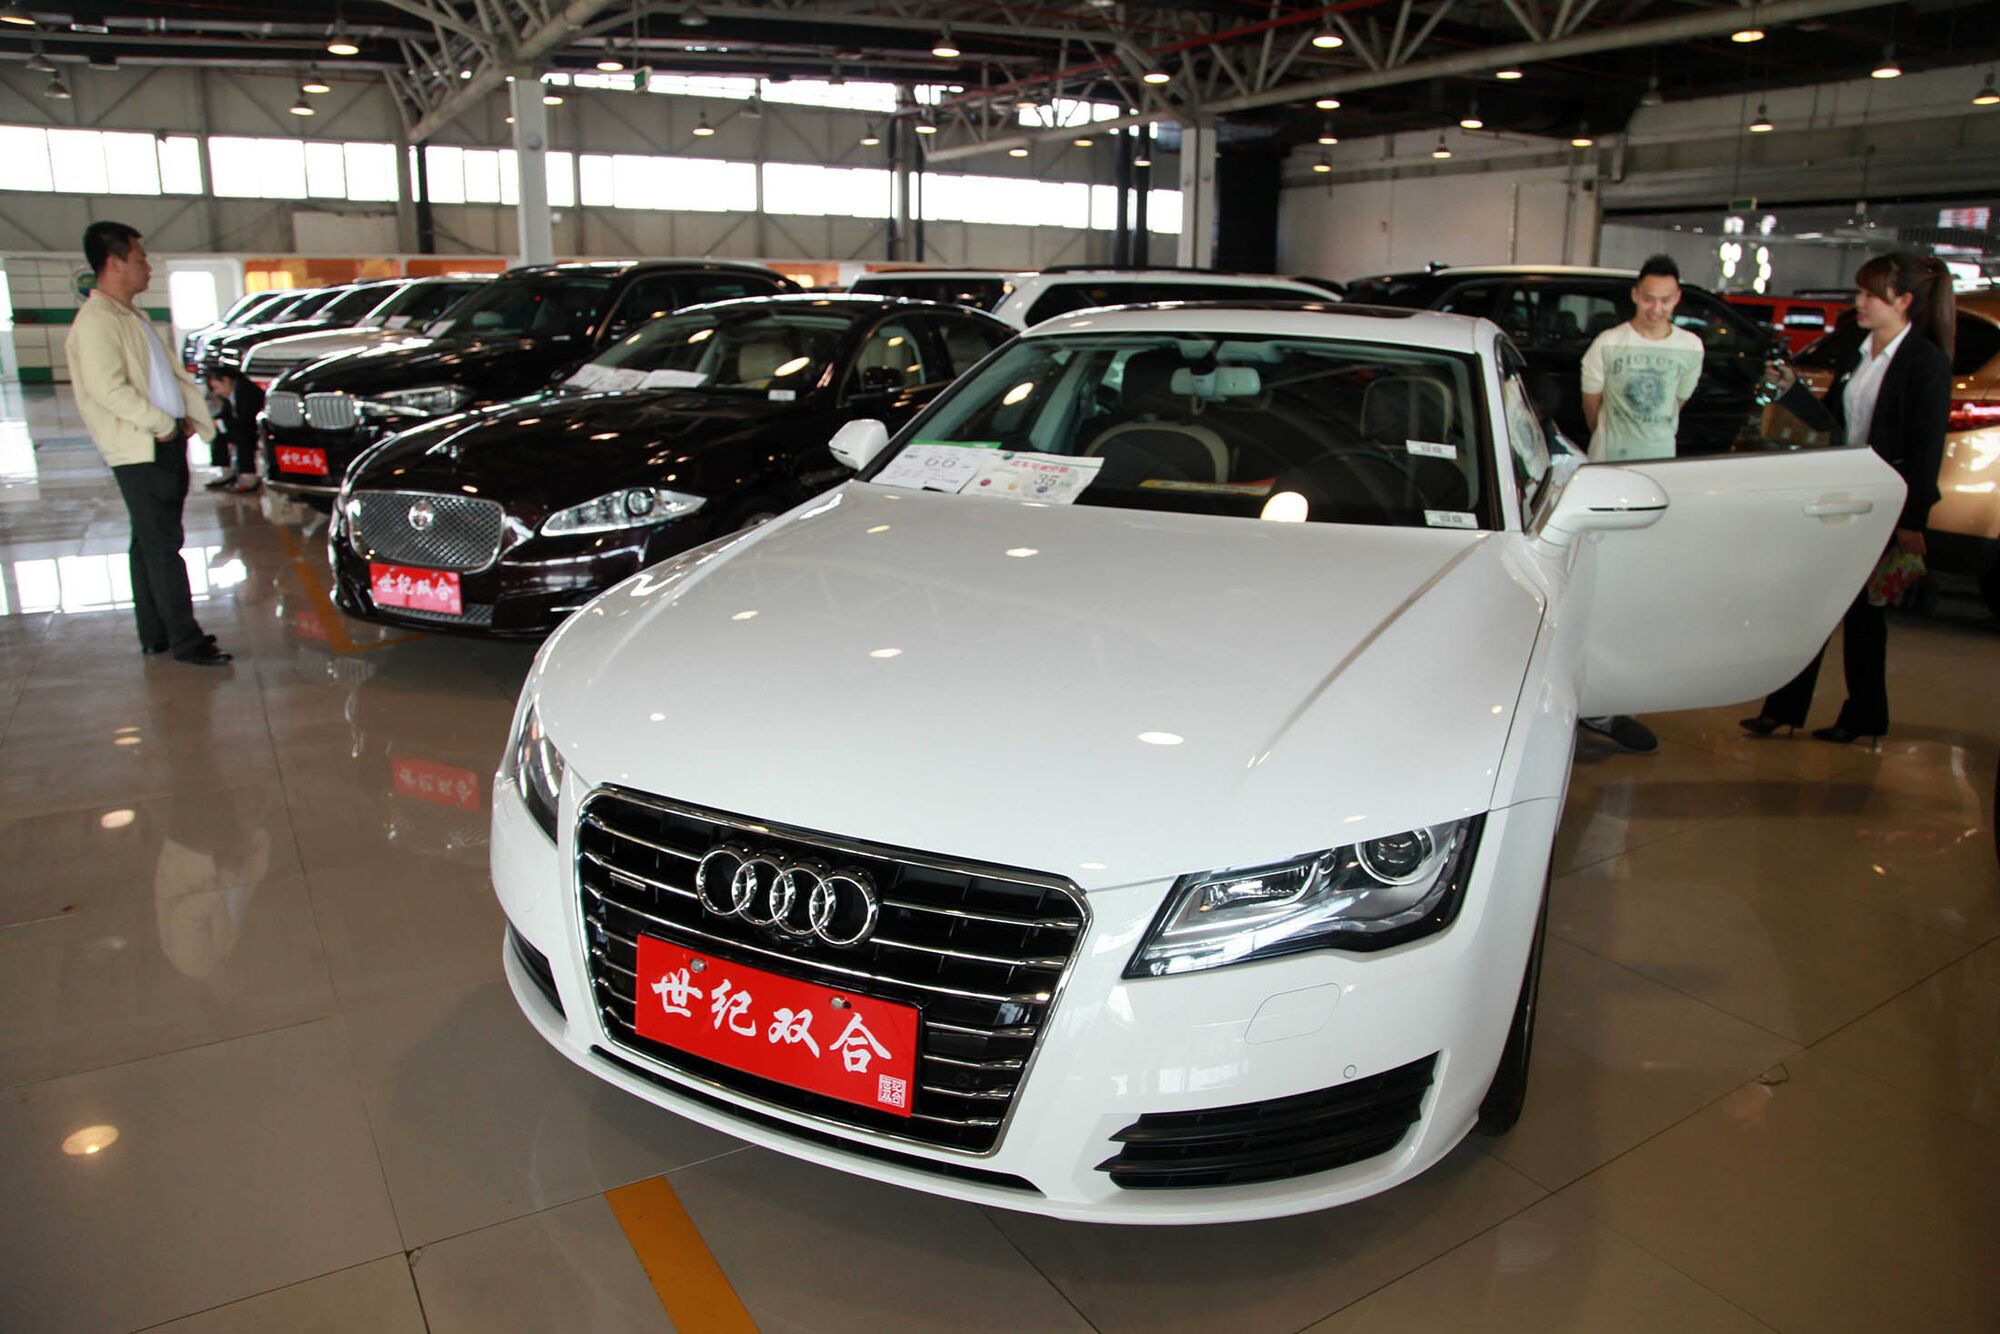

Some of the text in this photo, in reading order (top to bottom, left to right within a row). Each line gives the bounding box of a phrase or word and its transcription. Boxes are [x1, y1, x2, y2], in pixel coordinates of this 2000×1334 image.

[377, 573, 454, 601] 世纪双合
[651, 967, 892, 1073] 世纪双合
